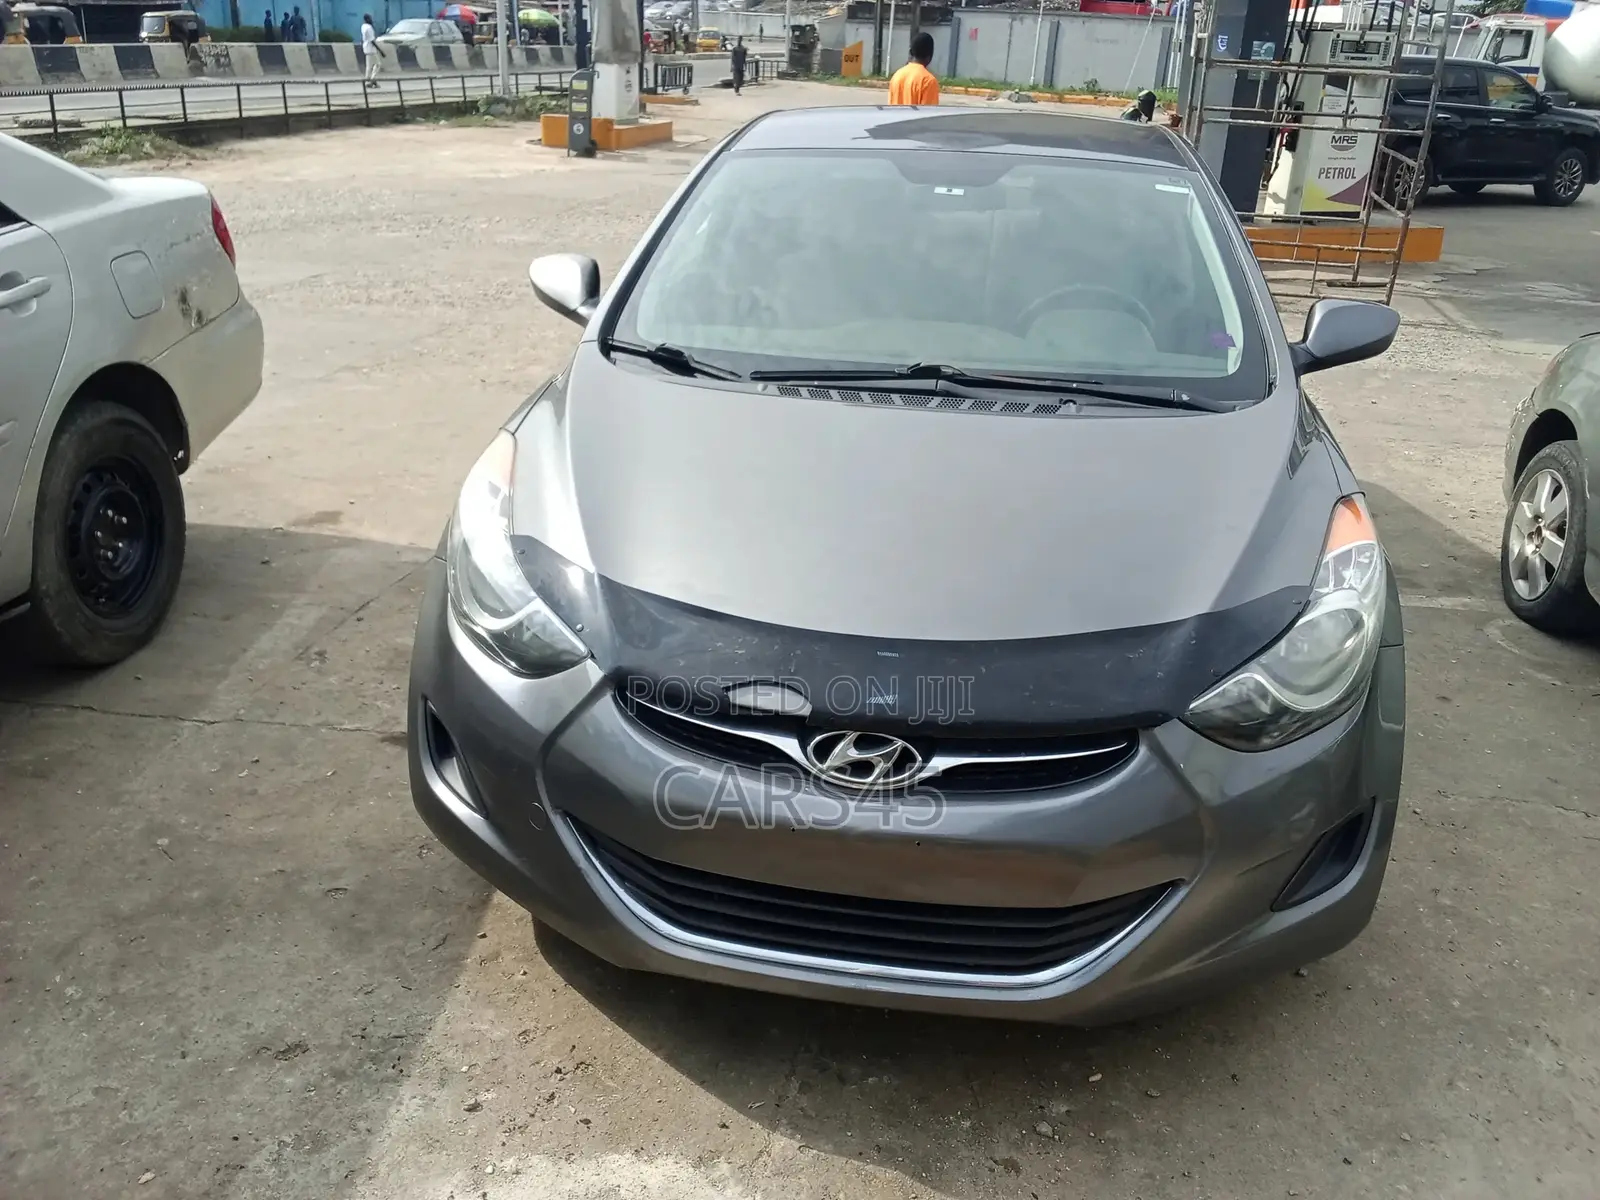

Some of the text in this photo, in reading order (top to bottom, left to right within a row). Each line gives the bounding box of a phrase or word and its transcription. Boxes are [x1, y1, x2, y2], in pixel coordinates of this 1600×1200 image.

[844, 54, 860, 63] OUT
[1330, 135, 1358, 145] MRS
[1318, 166, 1357, 180] PETROL
